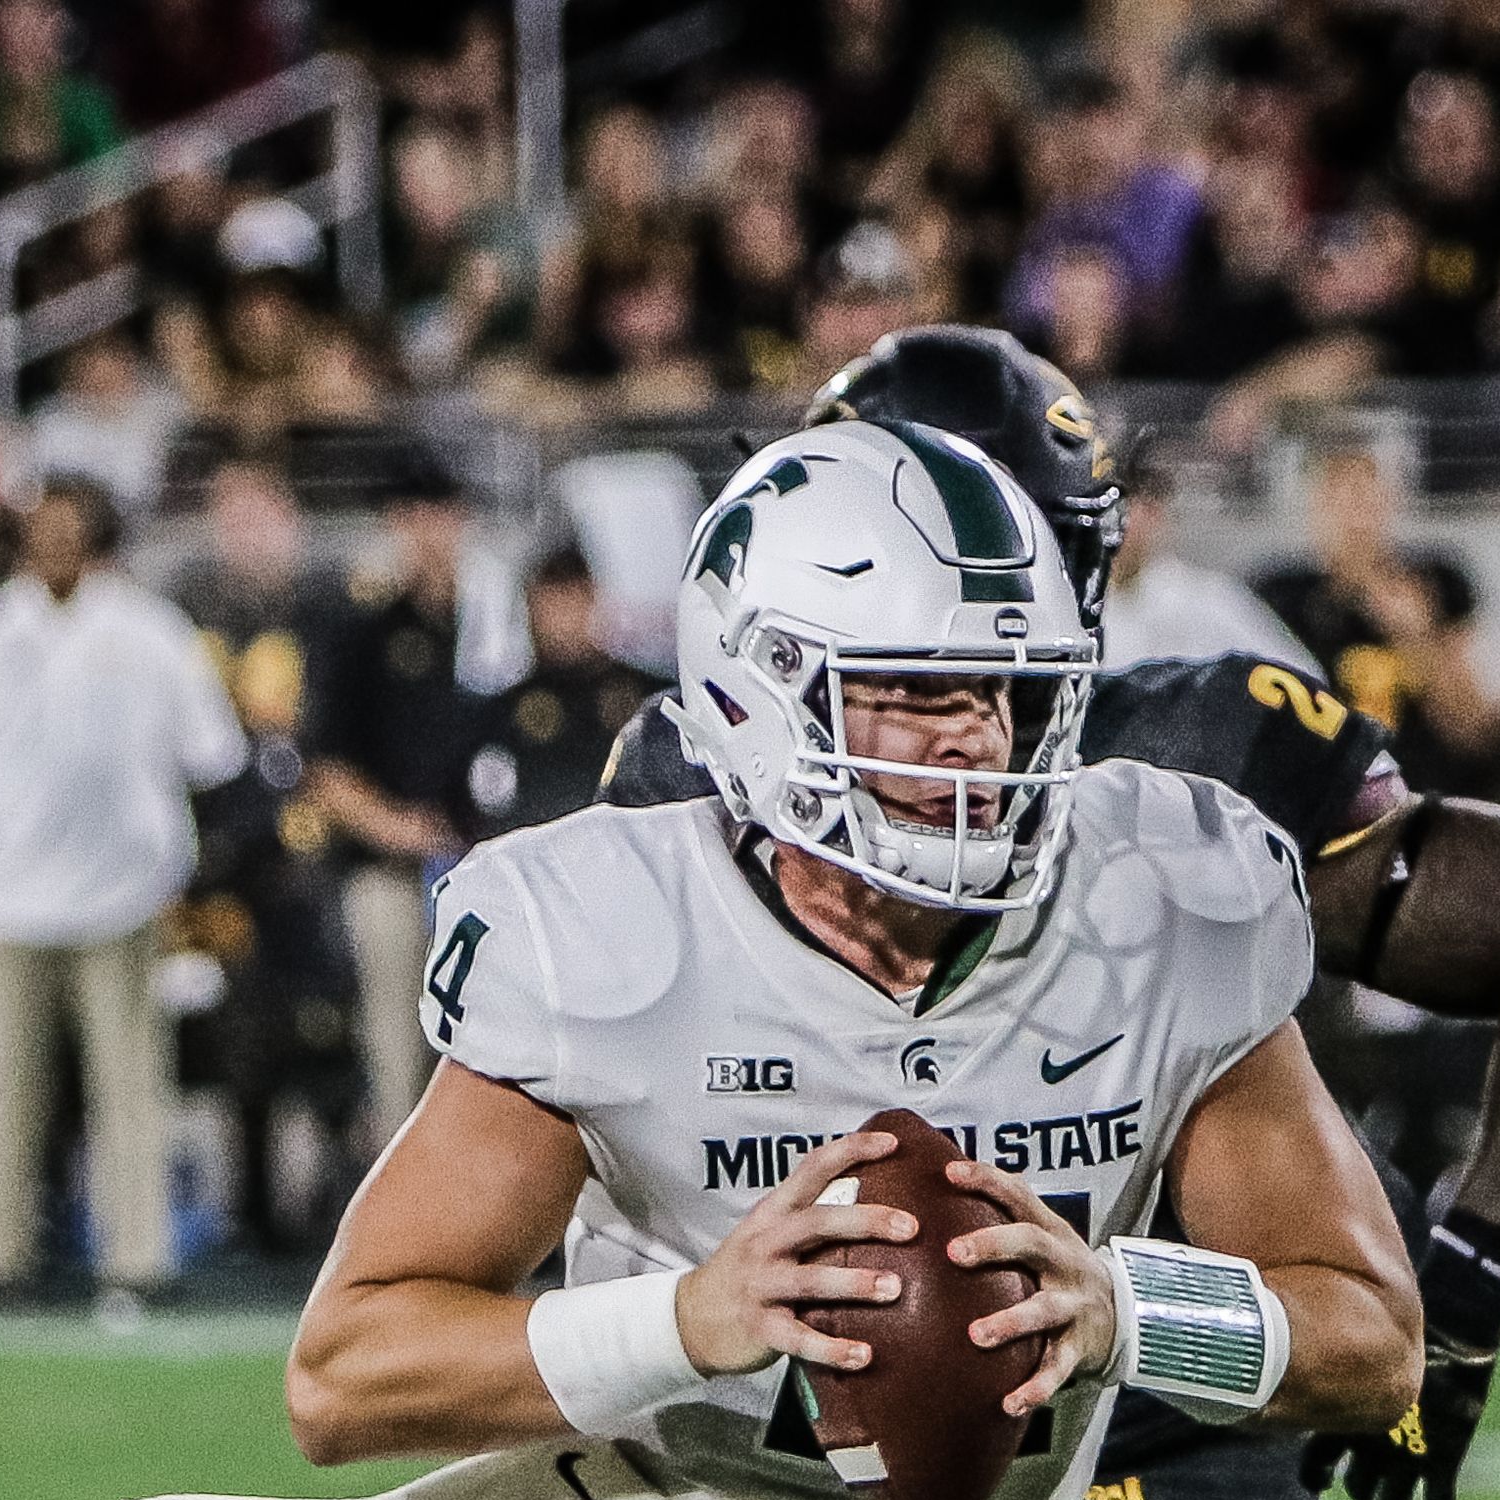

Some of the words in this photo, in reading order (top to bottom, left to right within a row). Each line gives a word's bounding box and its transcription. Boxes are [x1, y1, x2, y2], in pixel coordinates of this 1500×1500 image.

[1247, 663, 1348, 740] 2
[702, 1125, 978, 1189] MICN
[994, 1098, 1143, 1173] STATE
